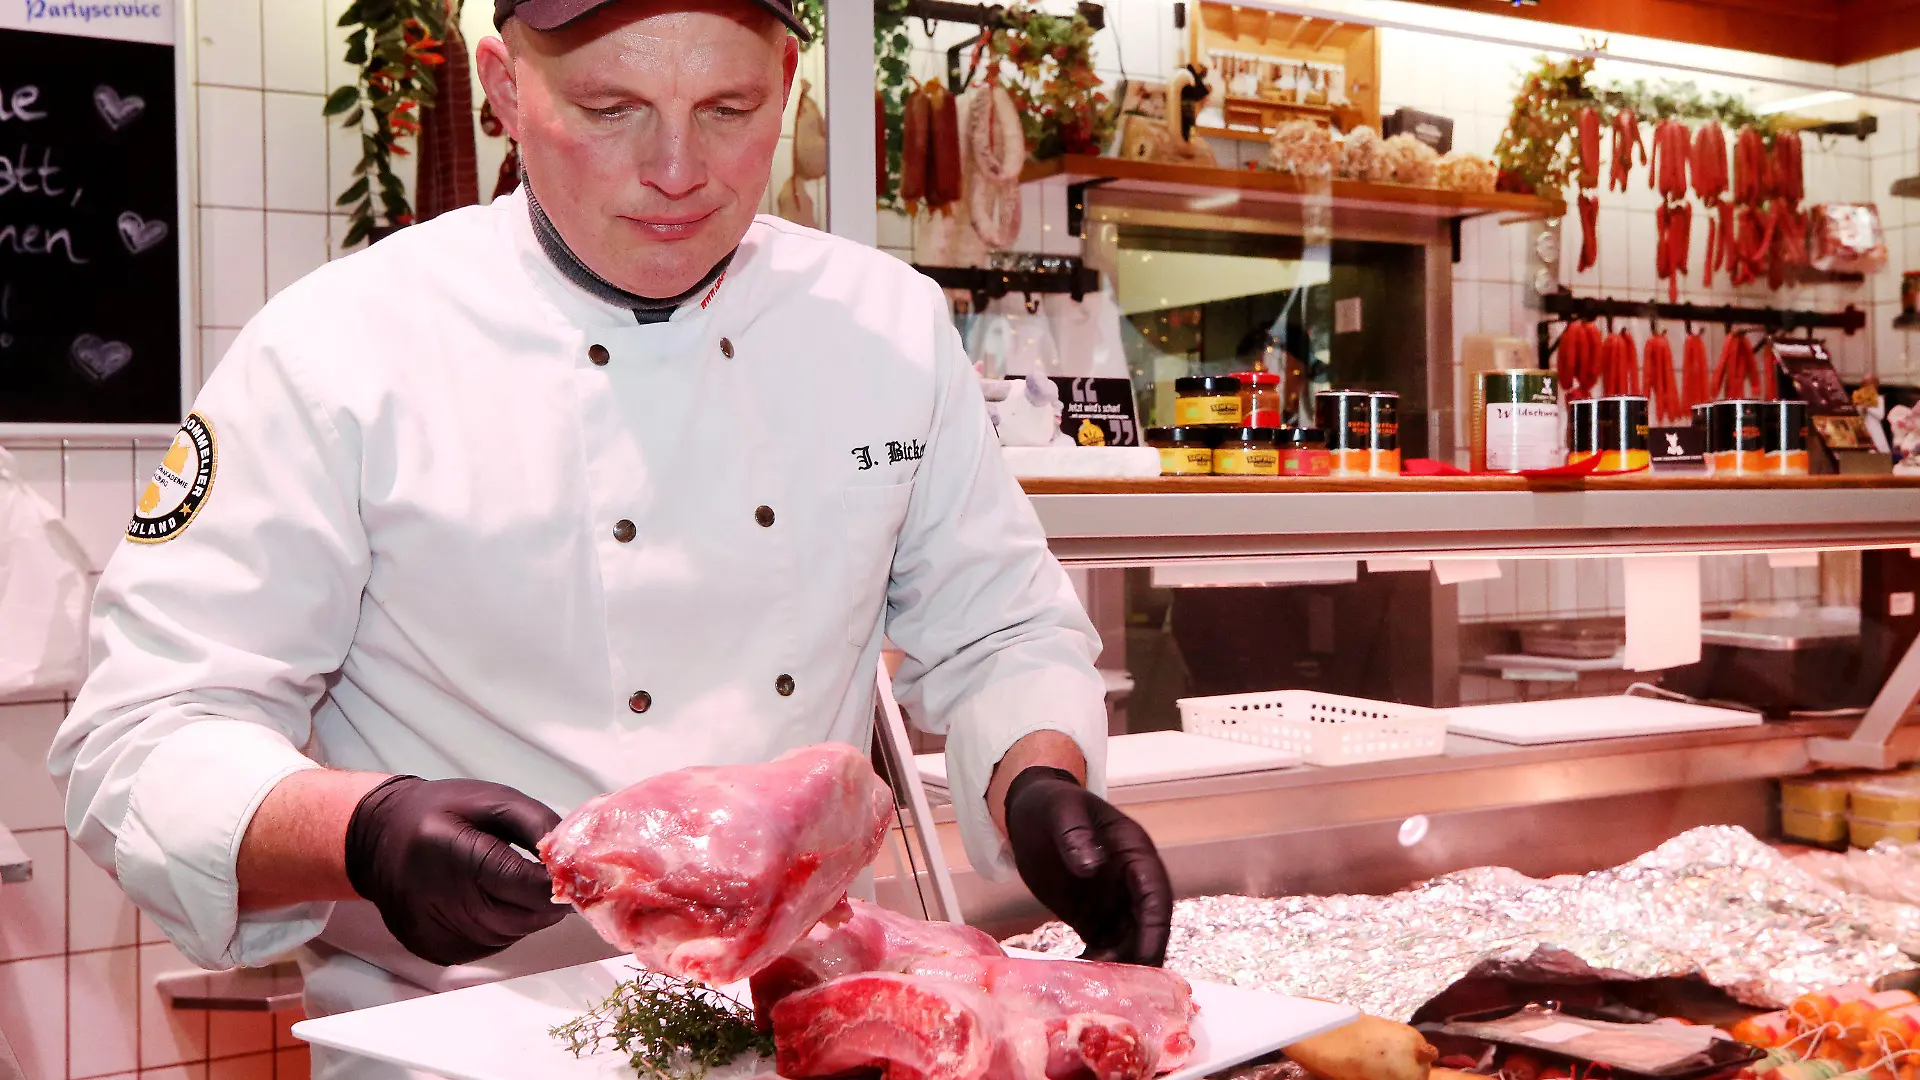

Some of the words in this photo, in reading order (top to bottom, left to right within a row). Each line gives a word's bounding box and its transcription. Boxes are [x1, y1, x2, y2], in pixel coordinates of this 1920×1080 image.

[25, 0, 162, 22] Partyservice
[0, 85, 48, 121] e
[1496, 408, 1559, 419] Wldschwe
[851, 445, 879, 471] J.
